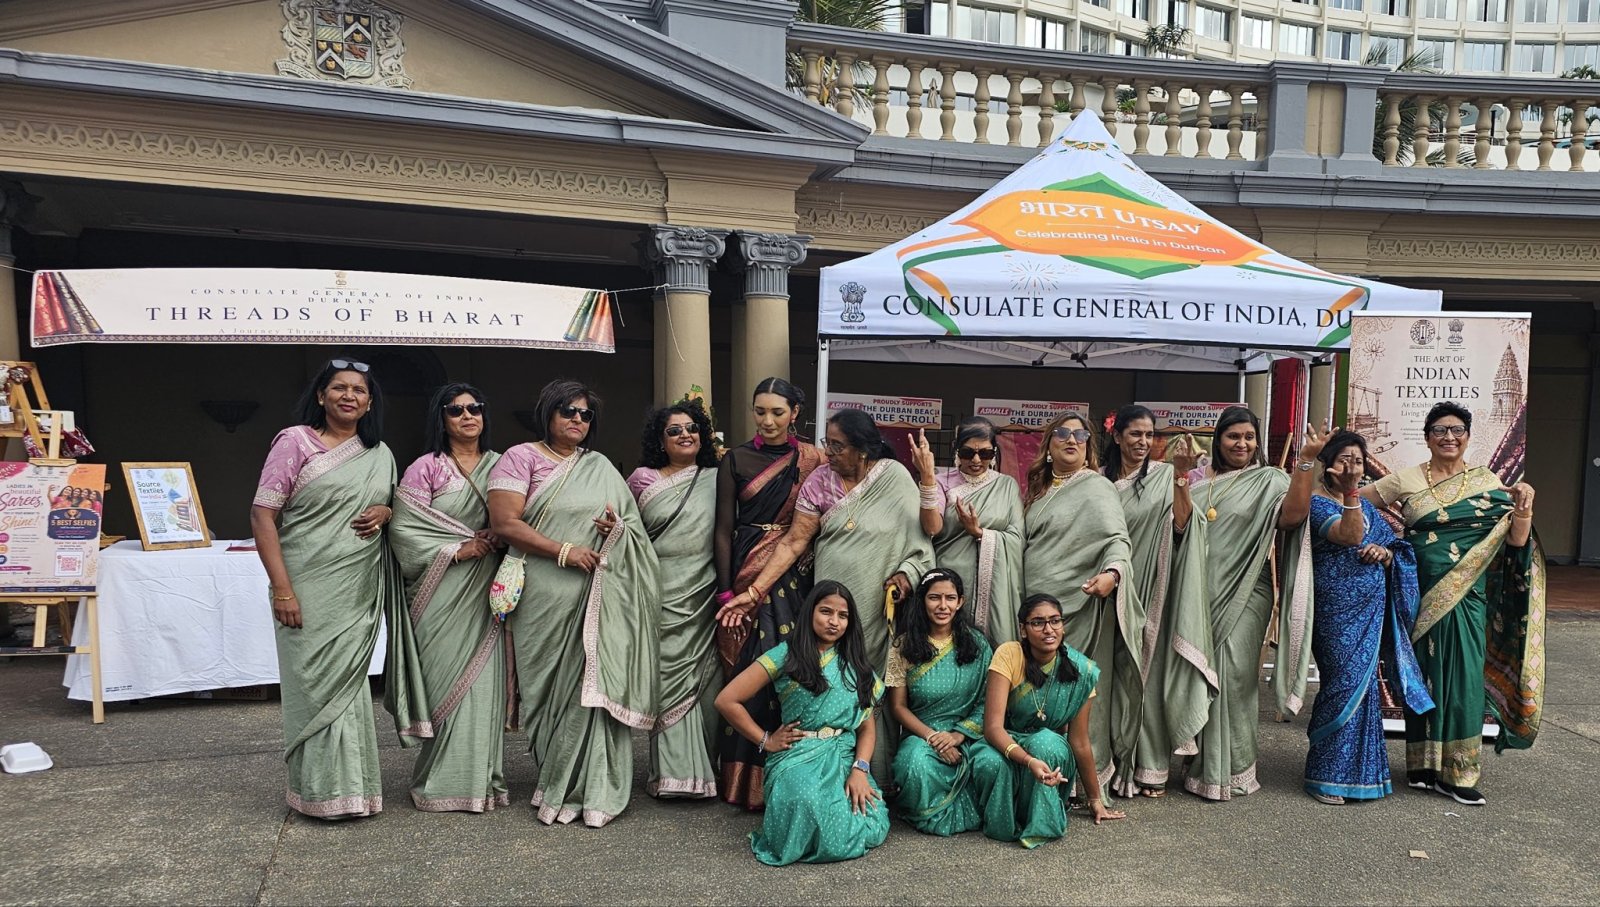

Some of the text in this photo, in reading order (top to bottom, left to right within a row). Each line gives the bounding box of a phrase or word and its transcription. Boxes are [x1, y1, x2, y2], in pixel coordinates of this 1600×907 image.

[1019, 201, 1105, 219] भारत
[1113, 208, 1201, 235] UTSAV
[1015, 229, 1109, 242] Celebrating
[1112, 234, 1150, 245] India
[1170, 241, 1227, 255] Durban
[191, 288, 299, 296] CONSULATE
[312, 289, 392, 298] GENERAL
[436, 294, 484, 302] INDIA
[146, 307, 524, 326] THREADS OF BHARAT
[883, 295, 1045, 317] CONSULATE
[1053, 298, 1174, 321] GENERAL
[1181, 301, 1216, 321] OF
[1225, 303, 1307, 328] INDIA,
[1414, 355, 1465, 363] THE ART OF
[1406, 367, 1471, 380] INDIAN
[1394, 385, 1480, 399] TEXTILES
[880, 406, 913, 415] DURBAN
[914, 408, 940, 416] BEACH
[869, 413, 938, 424] AREE STROLL
[1010, 417, 1042, 426] SAREE
[1168, 419, 1201, 427] SAREE
[1, 515, 40, 531] Shine!
